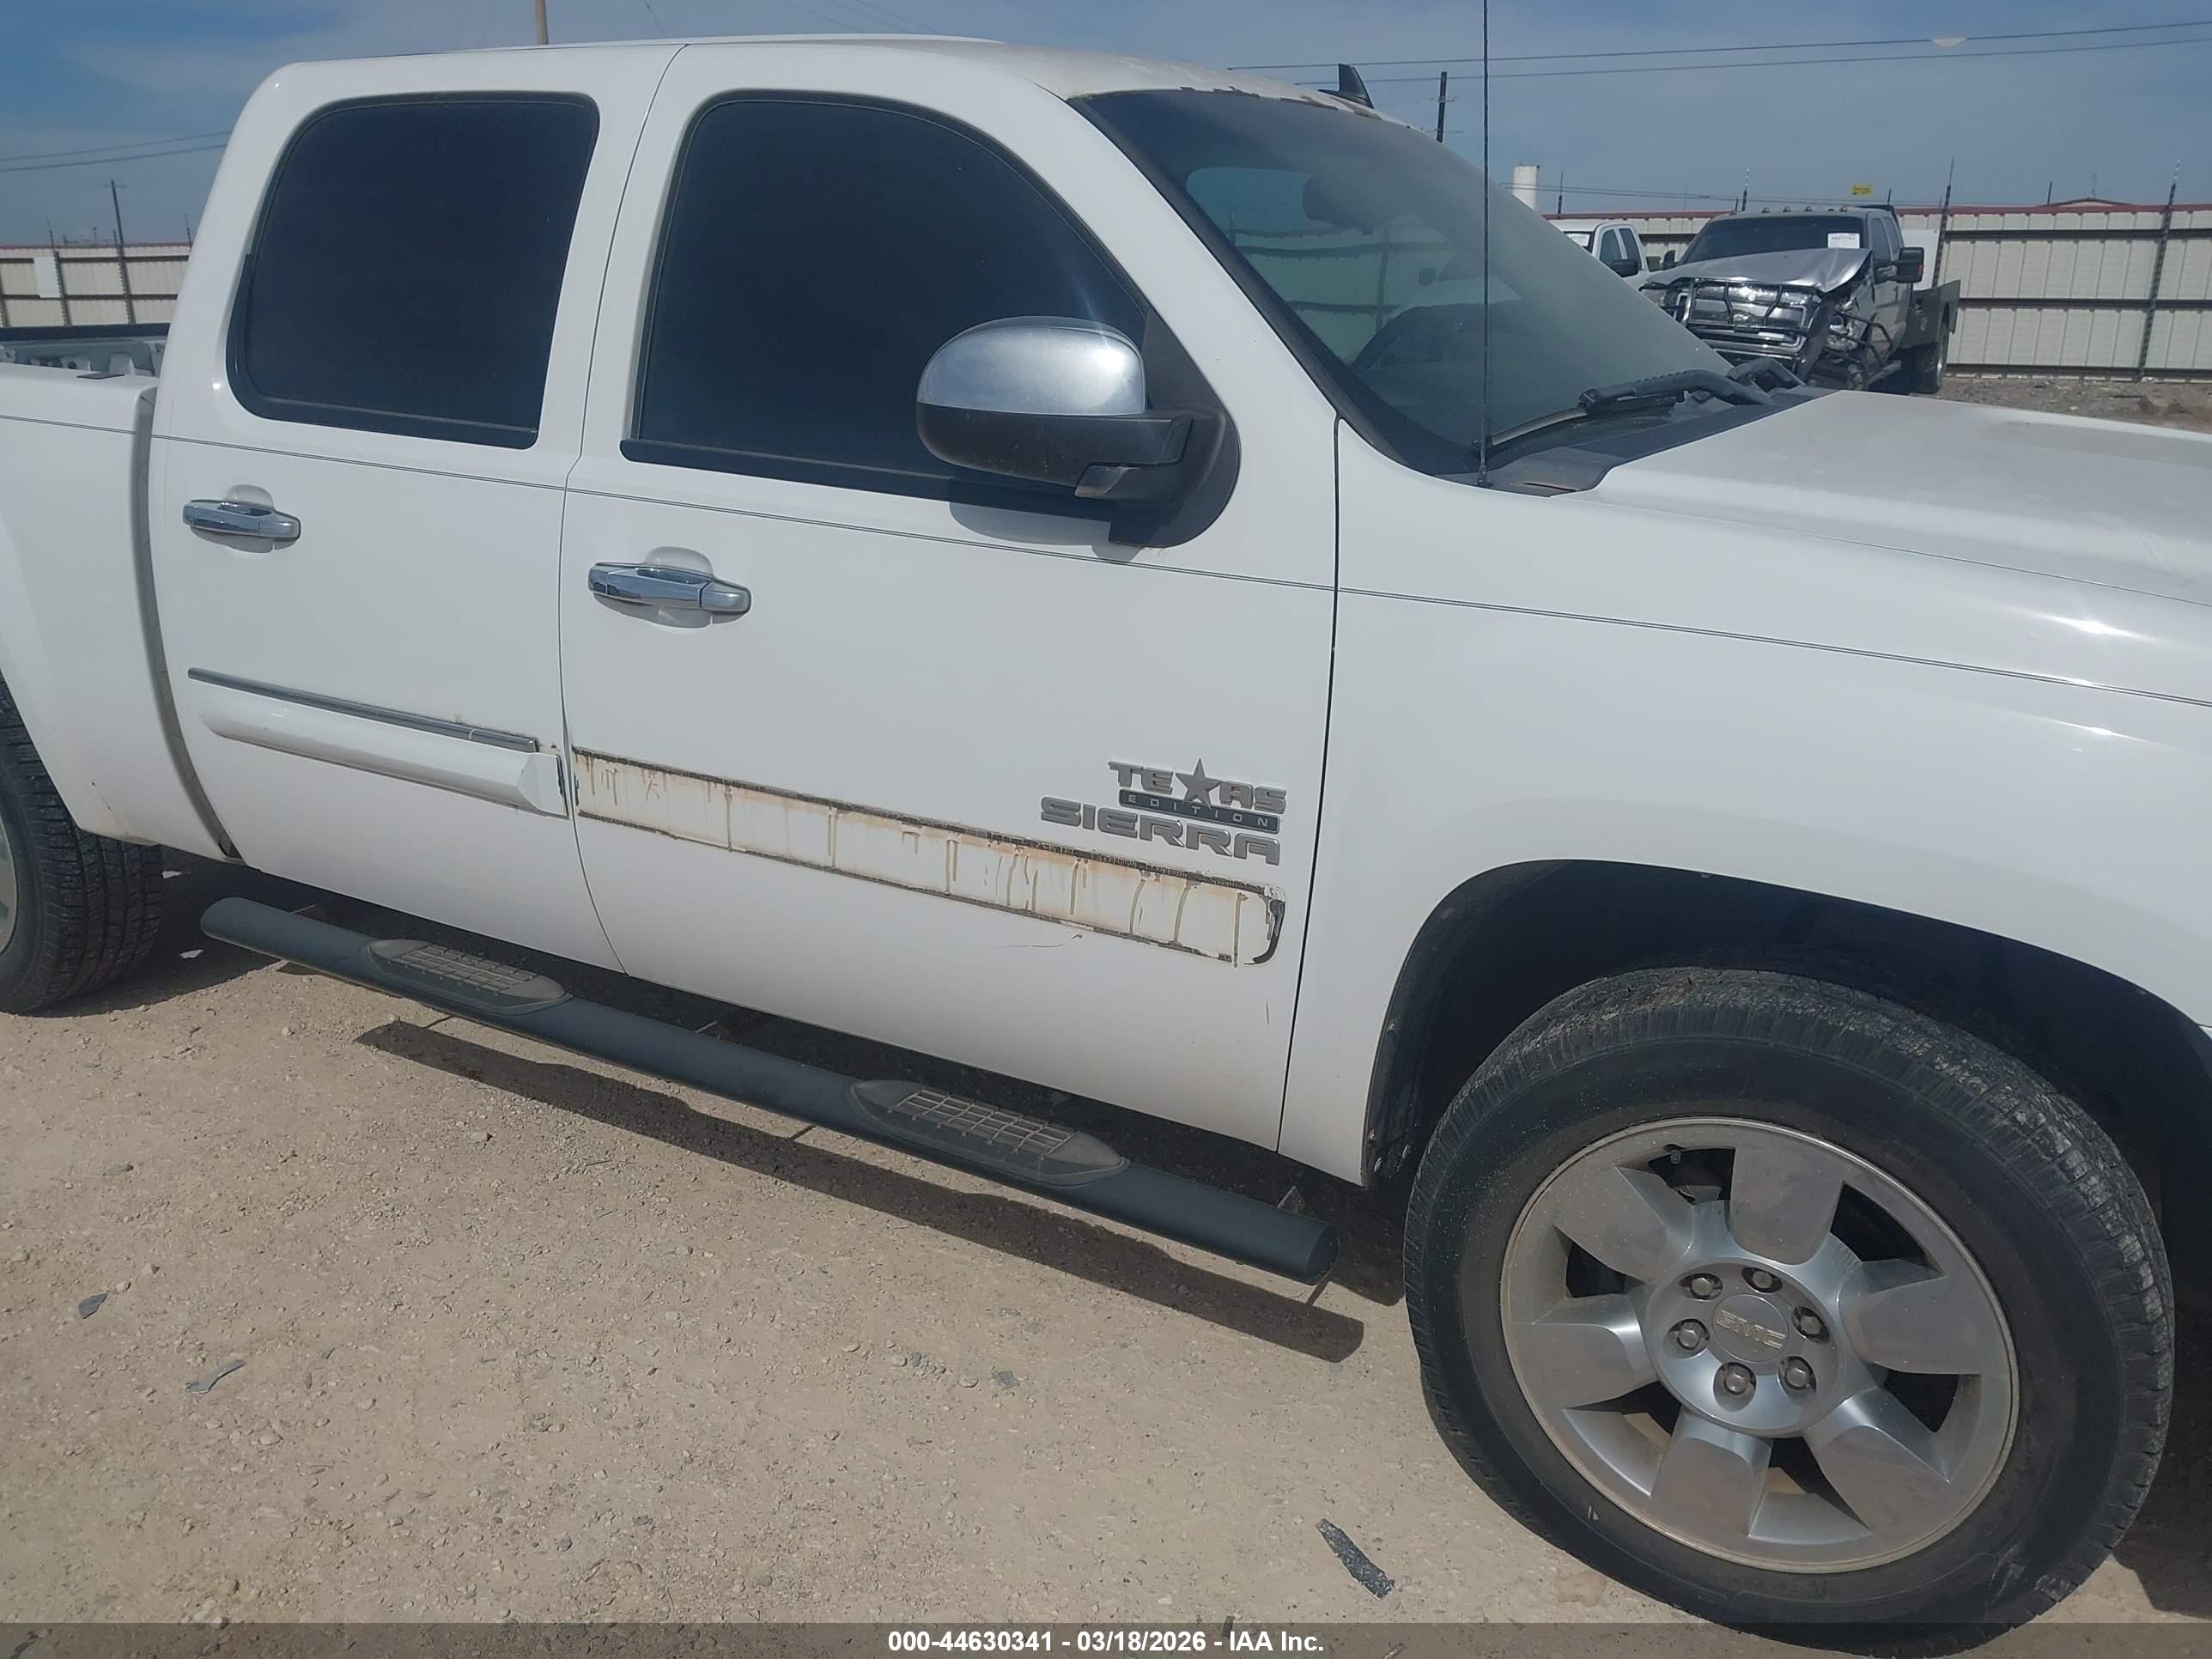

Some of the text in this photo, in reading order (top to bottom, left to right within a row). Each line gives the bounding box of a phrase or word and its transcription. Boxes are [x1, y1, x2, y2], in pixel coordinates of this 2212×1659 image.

[1128, 795, 1268, 827] EDITION
[1041, 797, 1280, 866] SIERRA
[1717, 1310, 1786, 1350] GMC
